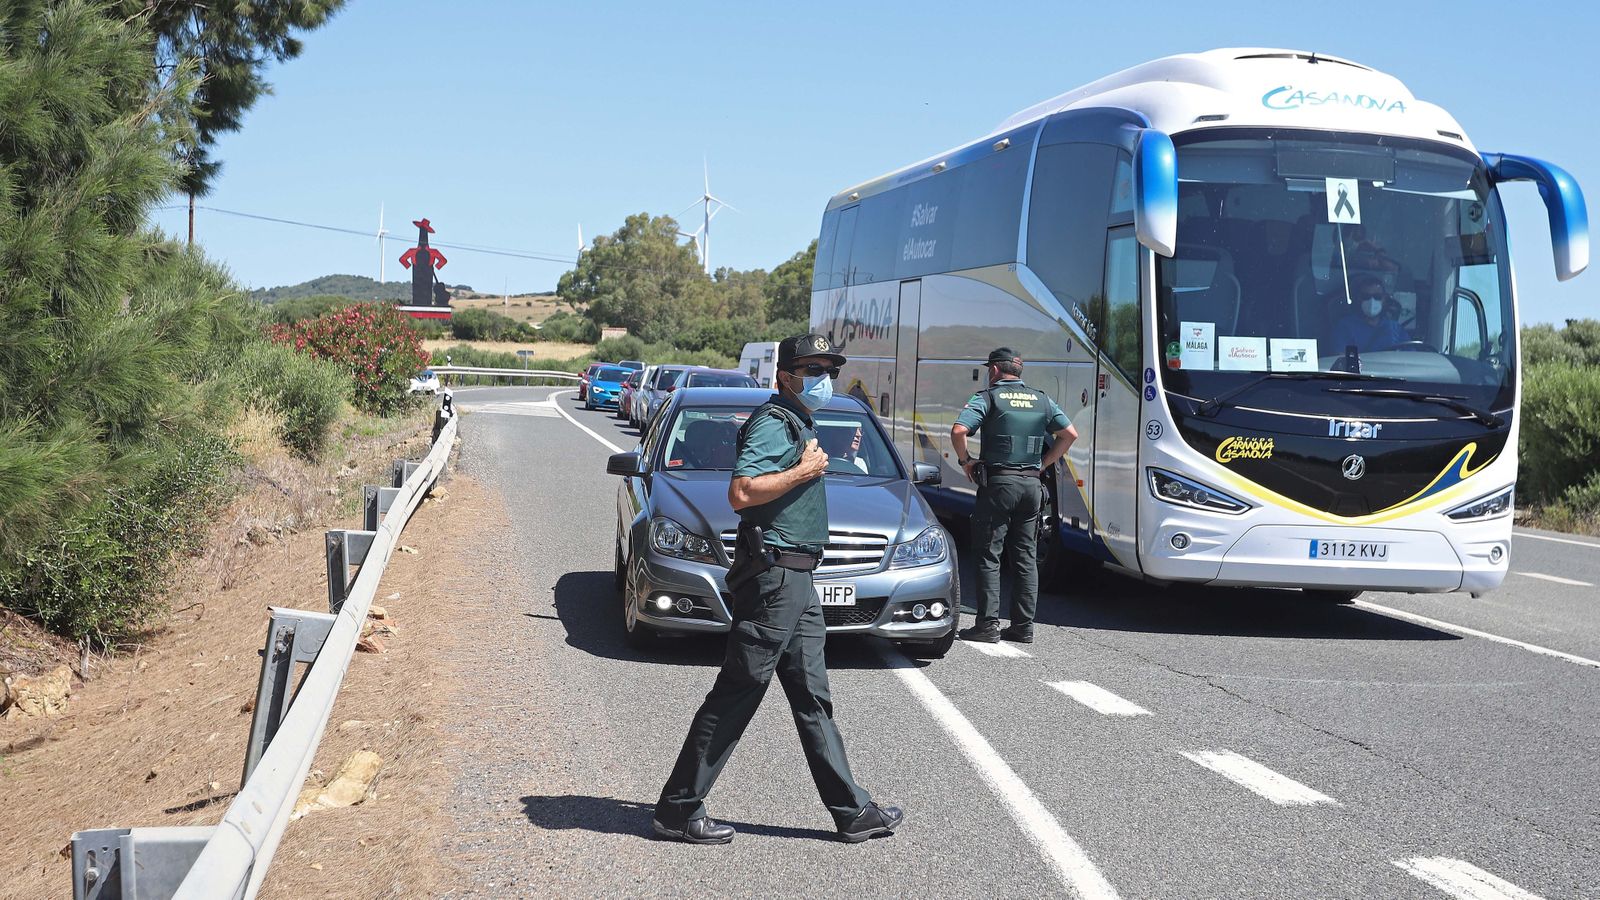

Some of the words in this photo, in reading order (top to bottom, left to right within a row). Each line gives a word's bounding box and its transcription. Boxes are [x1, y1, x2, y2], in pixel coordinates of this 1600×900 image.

[910, 202, 938, 228] #Salvar
[999, 392, 1039, 401] GUARDIA
[1009, 399, 1034, 408] CIVIL
[1147, 424, 1160, 435] 53
[1327, 418, 1382, 439] Irizar
[1321, 542, 1355, 557] 3112
[1360, 543, 1387, 558] KVJ
[823, 586, 854, 603] HFP
